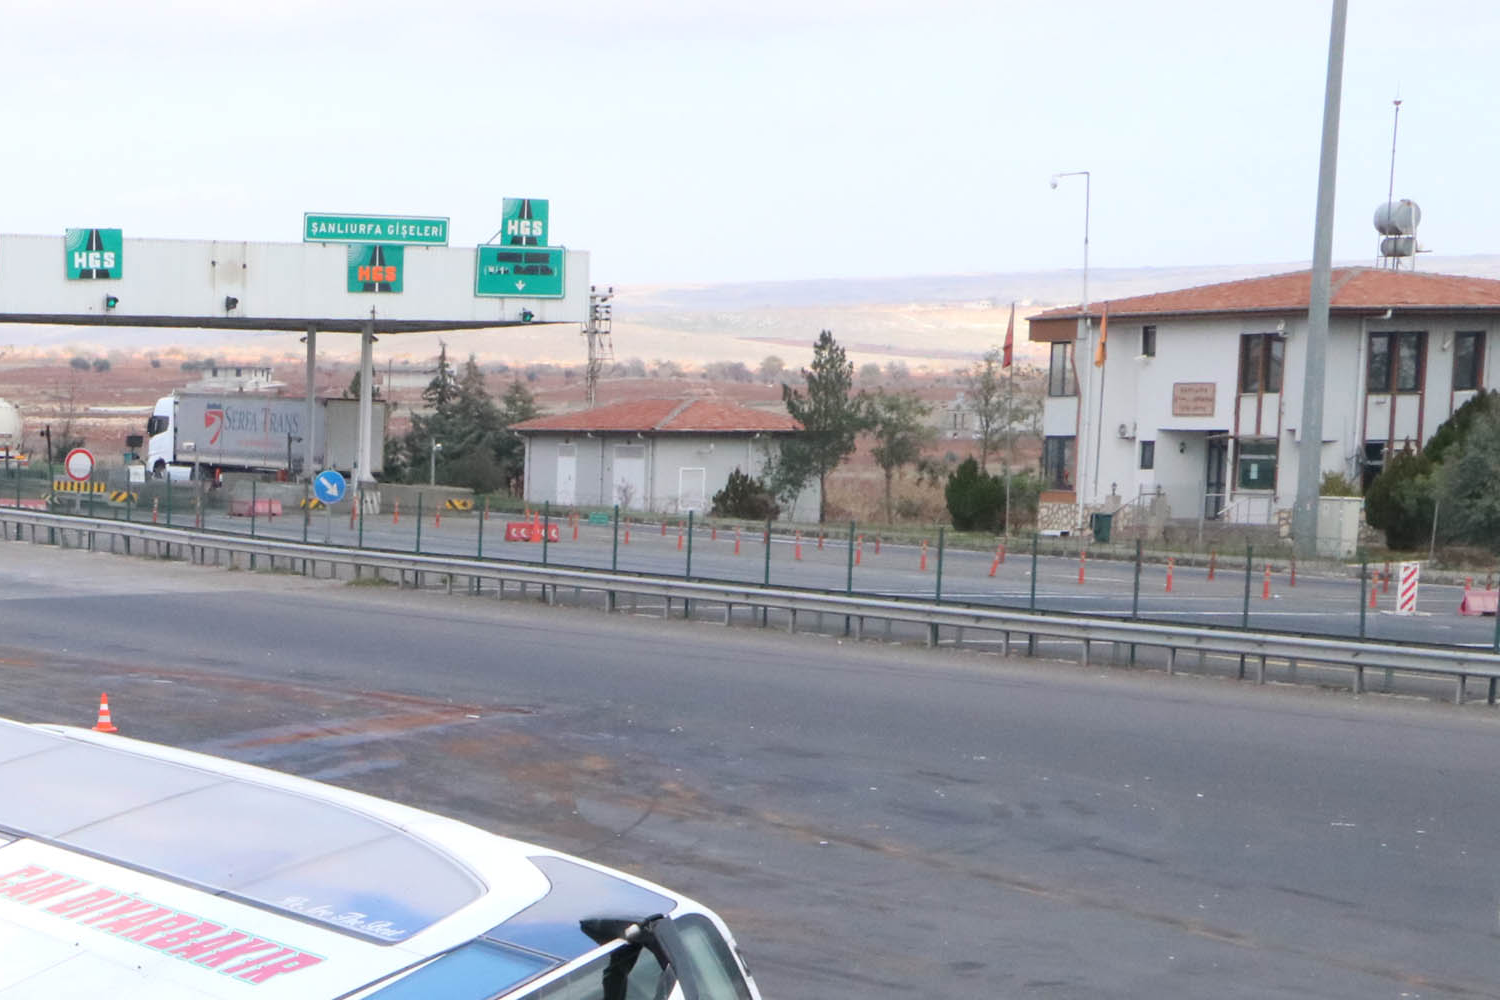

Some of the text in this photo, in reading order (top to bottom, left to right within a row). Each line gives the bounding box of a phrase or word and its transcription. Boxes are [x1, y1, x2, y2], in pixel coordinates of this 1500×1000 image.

[311, 221, 443, 239] ŞANLIURFA GİŞELERİ
[507, 219, 543, 236] HGS
[74, 250, 116, 269] HGS
[357, 265, 397, 282] HGS
